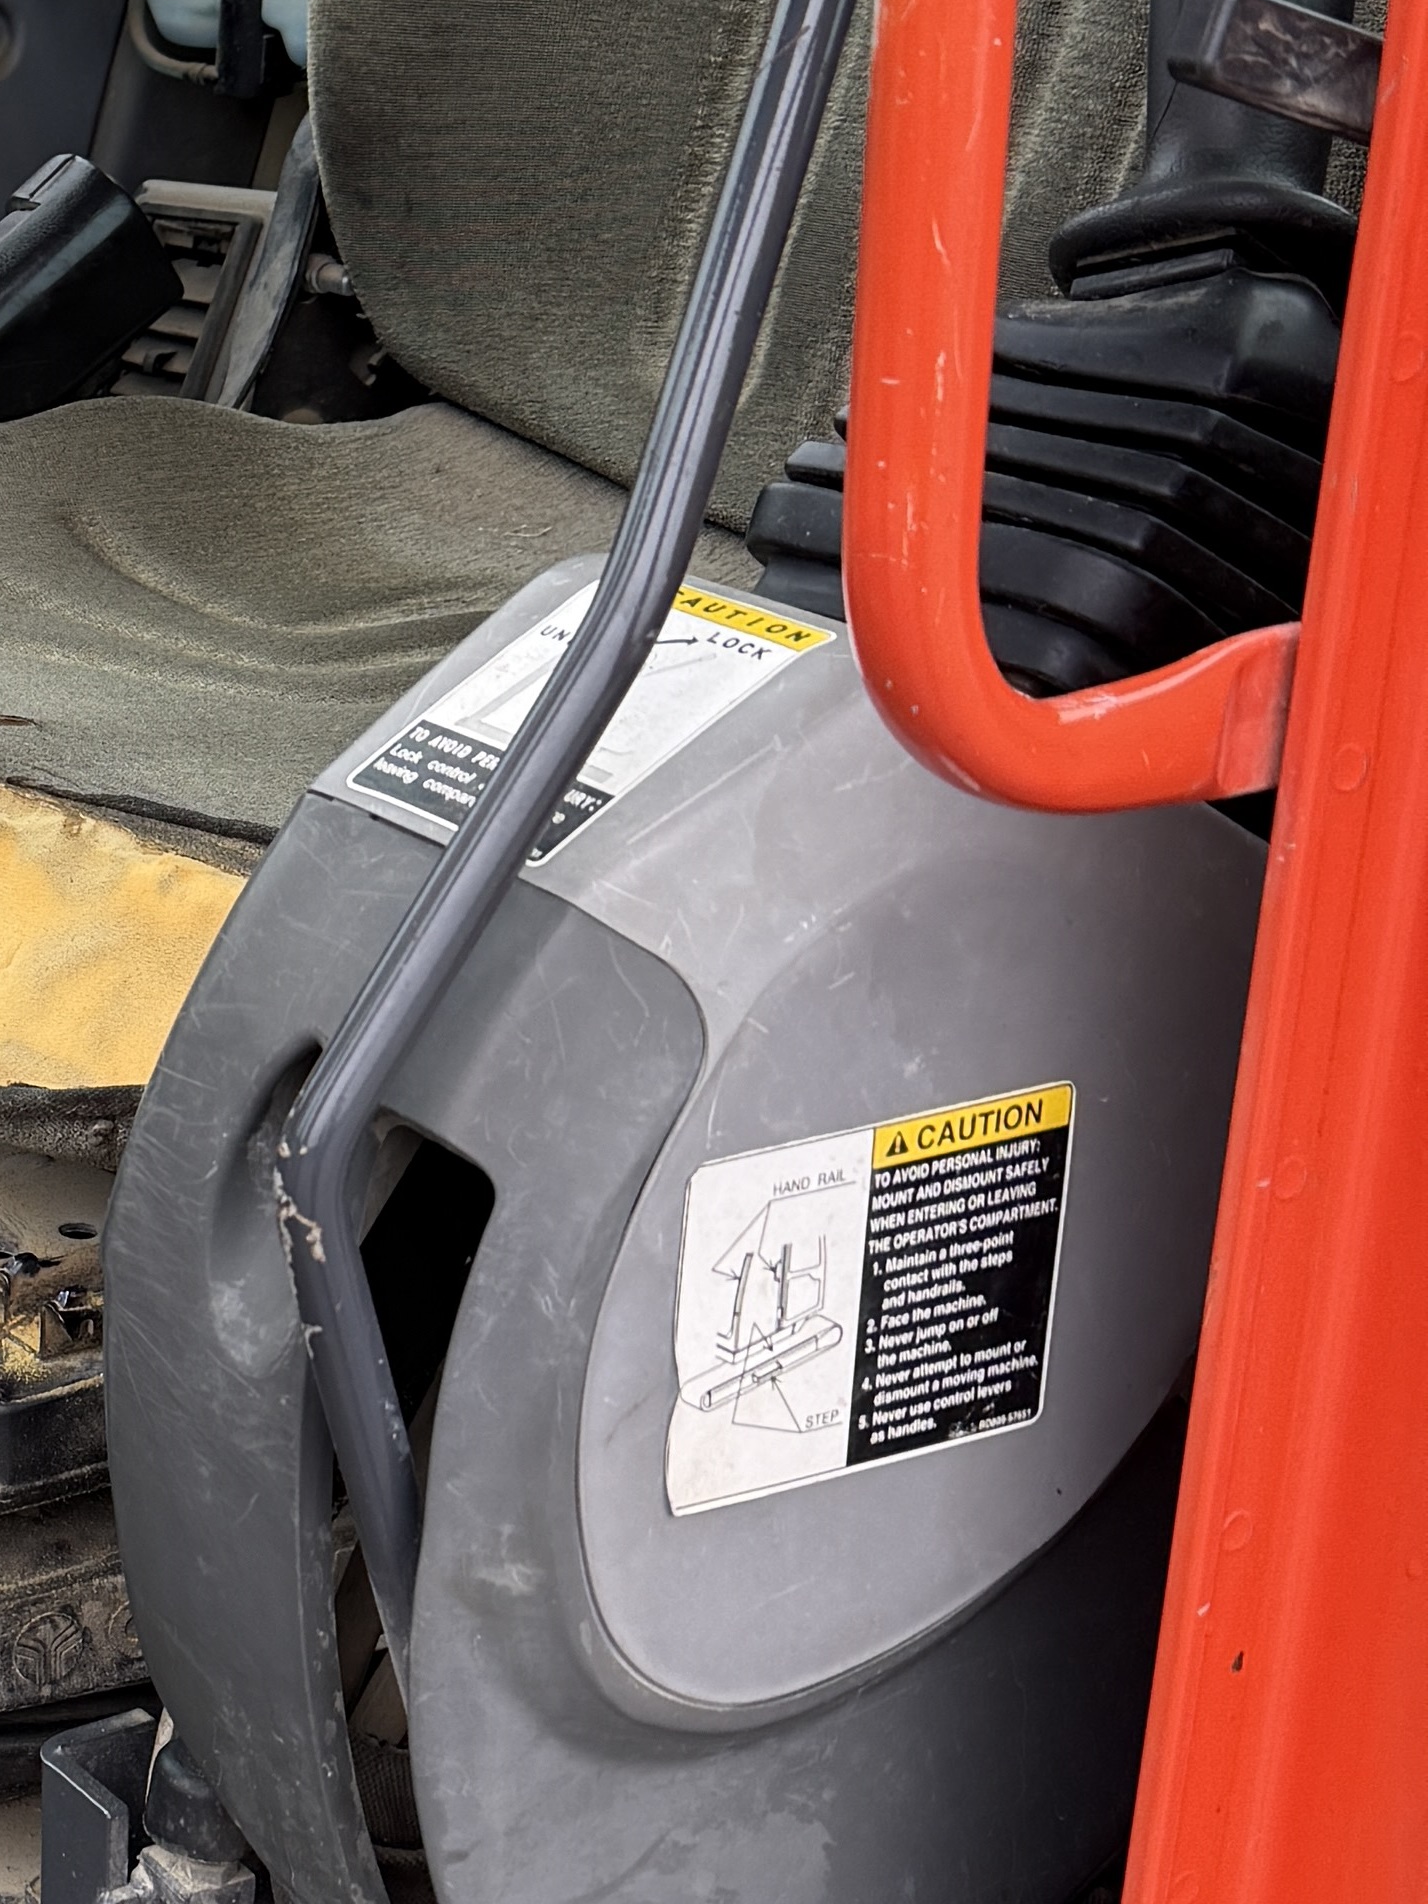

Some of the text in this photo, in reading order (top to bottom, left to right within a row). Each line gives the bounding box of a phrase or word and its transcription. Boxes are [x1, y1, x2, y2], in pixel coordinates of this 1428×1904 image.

[675, 590, 811, 643] AUTION
[707, 632, 772, 660] LOCK
[390, 743, 423, 765] Lock
[428, 760, 477, 785] control
[409, 726, 430, 742] TO
[428, 734, 473, 759] AVOID
[917, 1098, 1043, 1150] CAUTION
[773, 1168, 847, 1196] HAND RAIL
[872, 1157, 1050, 1211] MOUNT AND DISMOUNT SAFELY
[874, 1139, 1041, 1189] TO AVOID PERSONAL INJURY:
[868, 1197, 1059, 1255] THE OPERATOR'S COMPARTMENT.
[870, 1181, 1036, 1233] WHEN ENTERING OR LEAVING
[872, 1230, 1014, 1276] 1. Maintain a three-point
[883, 1250, 1013, 1292] contact with the steps
[866, 1294, 986, 1334] 2. Face the machine.
[882, 1279, 966, 1311] and handrails.
[864, 1307, 999, 1354] 3. Never jump on or off
[861, 1339, 1027, 1391] 4. Never attempt to mount or
[877, 1340, 952, 1369] the machine.
[874, 1354, 1039, 1407] dismount a moving machine.
[804, 1410, 840, 1429] STEP
[858, 1379, 1012, 1430] 5. Never use control levers
[870, 1417, 937, 1445] as handles.
